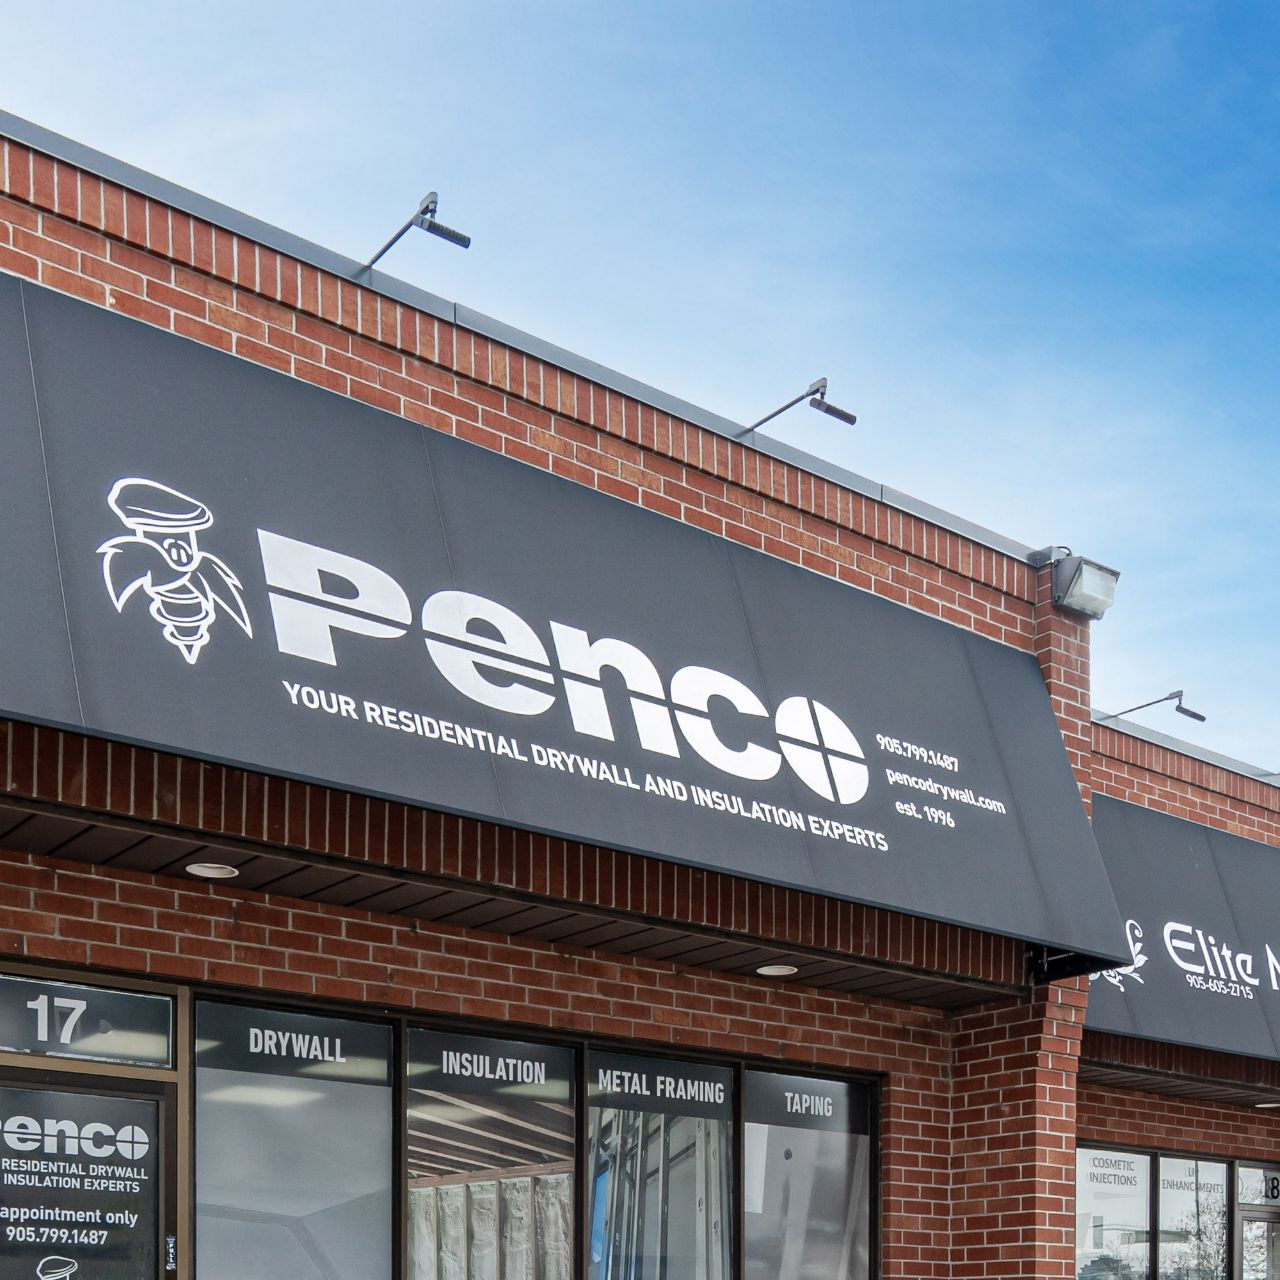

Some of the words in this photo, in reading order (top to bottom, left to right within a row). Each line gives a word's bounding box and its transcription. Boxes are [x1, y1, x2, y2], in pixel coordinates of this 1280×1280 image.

[257, 528, 871, 806] Penco
[281, 680, 360, 720] YOUR
[363, 700, 529, 762] RESIDENTIAL
[530, 743, 641, 791] DRYWALL
[645, 773, 689, 802] AND
[691, 784, 807, 832] INSULATION
[808, 814, 889, 852] EXPERTS
[875, 733, 960, 773] 905.799.1487
[885, 768, 1007, 815] pencodrywall.com
[895, 801, 923, 819] est.
[923, 805, 956, 828] 1996
[1162, 921, 1260, 986] Elite
[1185, 973, 1254, 1000] 905-605-2715
[26, 994, 88, 1045] 17
[249, 1027, 347, 1064] DRYWALL
[442, 1050, 546, 1086] INSULATION
[598, 1068, 651, 1096] METAL
[657, 1075, 725, 1105] FRAMING
[785, 1091, 833, 1118] TAPING
[2, 1157, 87, 1176] RESIDENTIAL
[90, 1164, 149, 1180] DRYWALL
[1089, 1172, 1137, 1187] INJECTIONS
[1092, 1157, 1135, 1172] COSMETIC
[4, 1172, 81, 1189] INSULATION
[85, 1178, 141, 1193] EXPERTS
[0, 1207, 102, 1225] appointment
[105, 1210, 139, 1227] only
[5, 1225, 109, 1245] 905.799.1487
